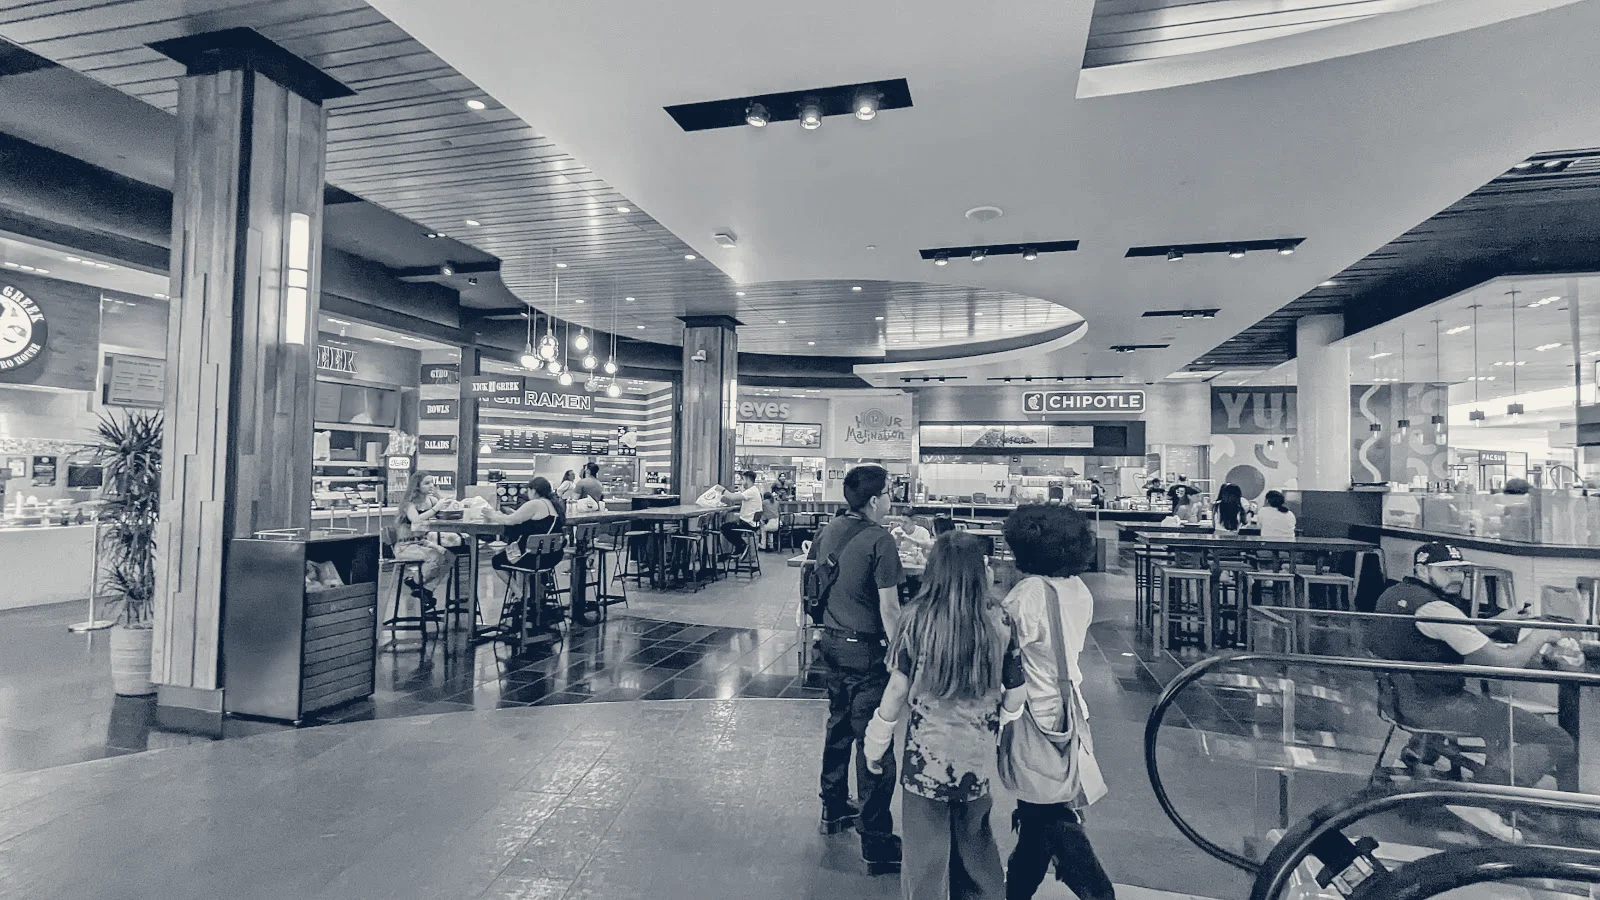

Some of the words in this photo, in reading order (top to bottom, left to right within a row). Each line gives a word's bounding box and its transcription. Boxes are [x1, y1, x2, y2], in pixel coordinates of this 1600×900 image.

[2, 285, 45, 323] GREEK
[430, 369, 449, 379] GYRO
[496, 381, 520, 391] GREEK
[524, 390, 591, 410] RAMEN
[1049, 395, 1141, 409] CHIPOTLE
[427, 404, 450, 414] BOWLS
[736, 401, 790, 419] eyes
[424, 440, 450, 450] SALADS
